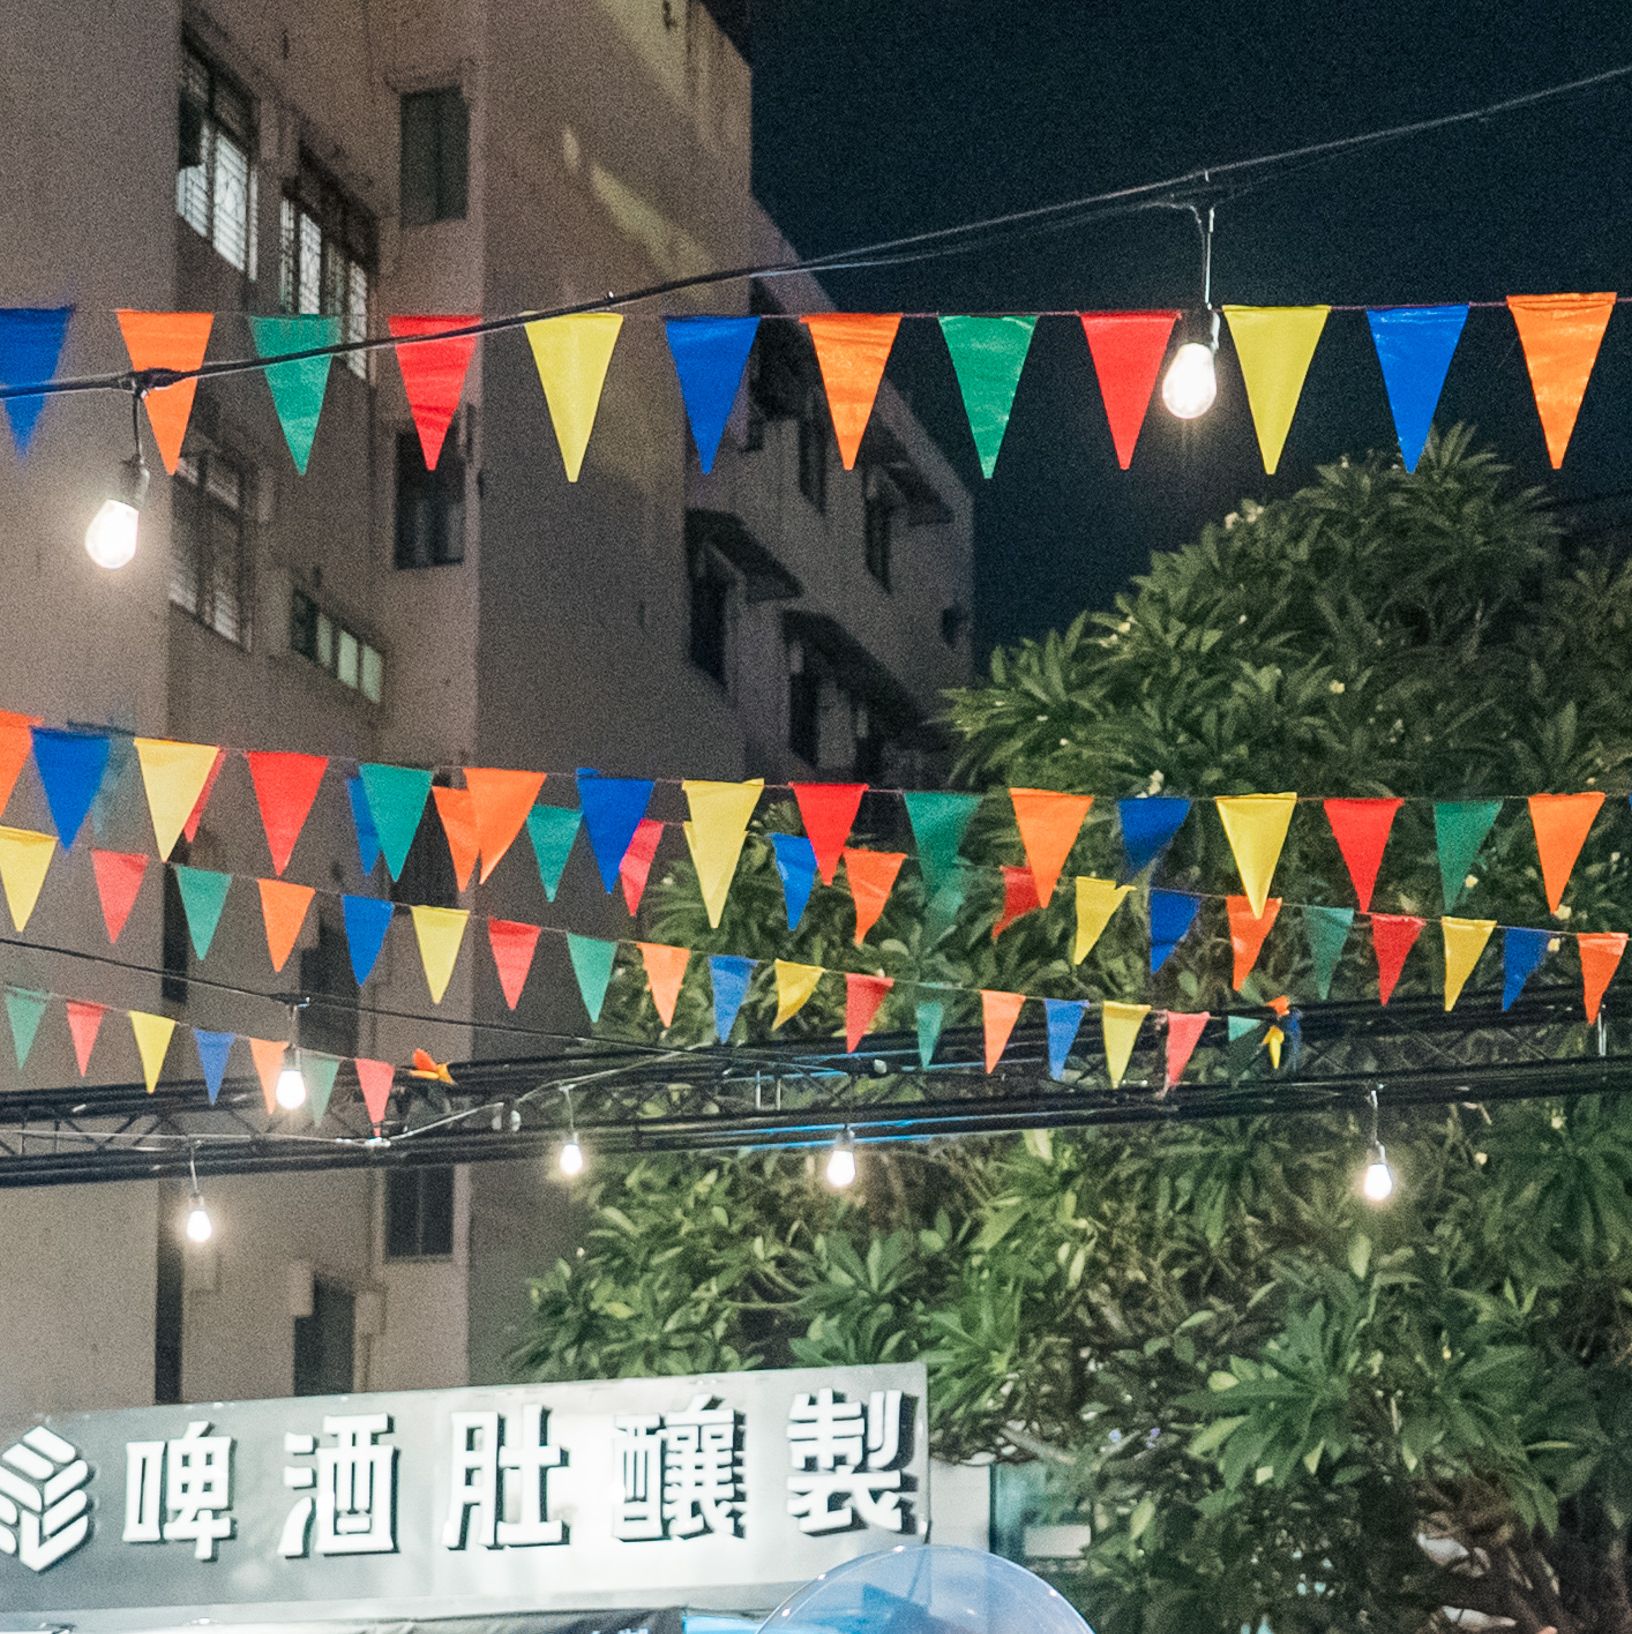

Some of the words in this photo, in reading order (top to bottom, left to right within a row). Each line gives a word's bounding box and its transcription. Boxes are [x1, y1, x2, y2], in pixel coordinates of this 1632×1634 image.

[122, 1388, 921, 1558] 啤酒肚釀製
